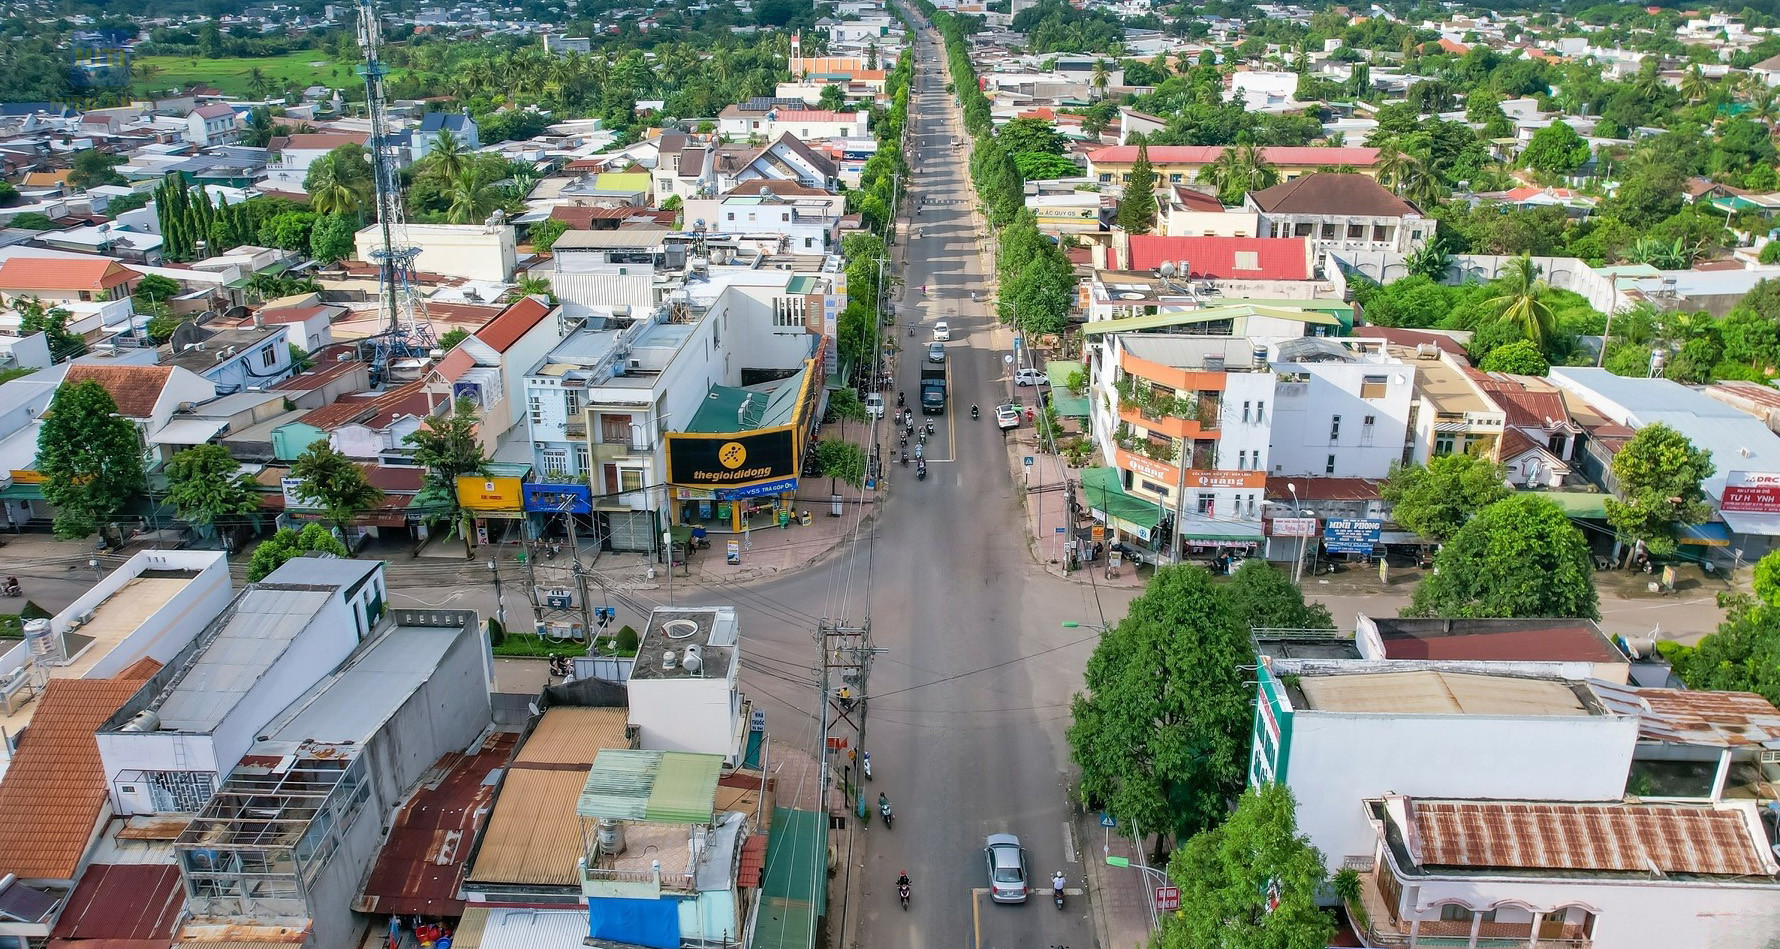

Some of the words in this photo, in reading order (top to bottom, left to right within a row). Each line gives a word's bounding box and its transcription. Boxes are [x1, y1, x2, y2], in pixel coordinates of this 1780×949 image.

[693, 466, 772, 482] thegioididong
[1198, 475, 1244, 486] Quảng
[1329, 521, 1351, 529] MINH
[1353, 522, 1381, 530] PHONG
